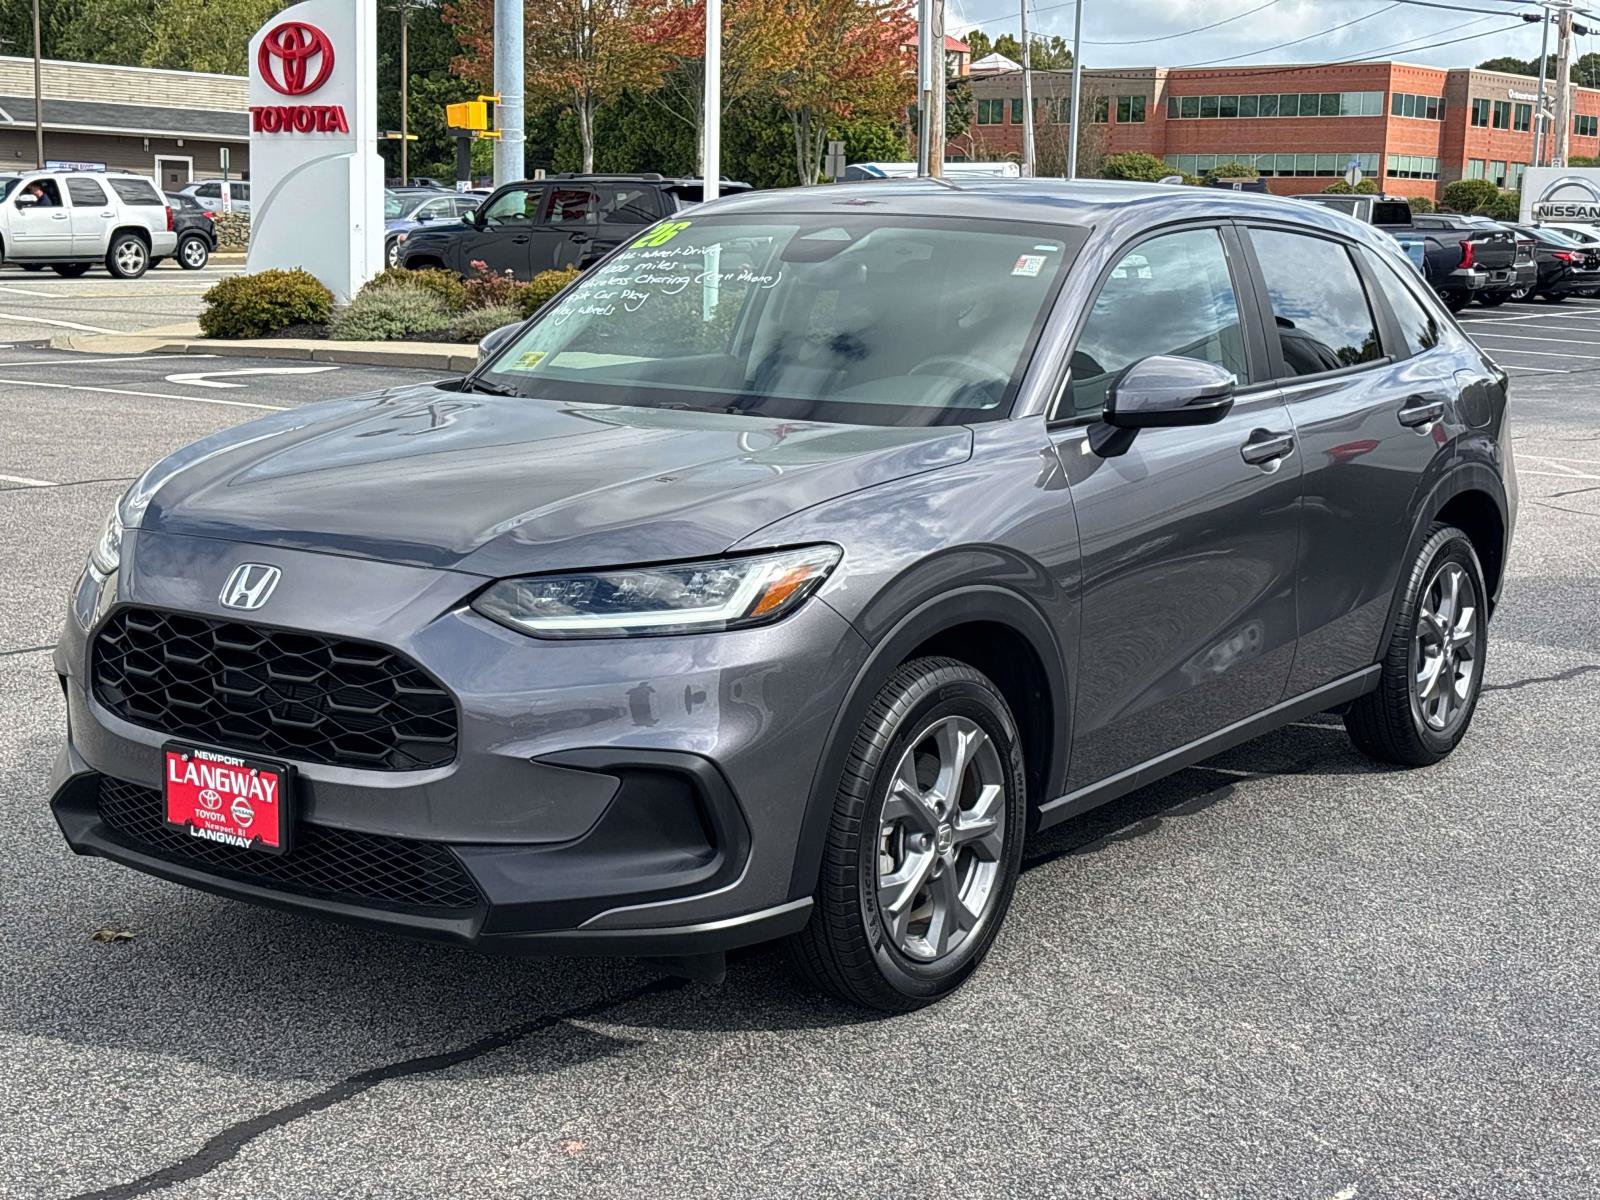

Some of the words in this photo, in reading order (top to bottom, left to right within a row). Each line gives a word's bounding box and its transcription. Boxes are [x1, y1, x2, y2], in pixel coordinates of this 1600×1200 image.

[249, 105, 349, 133] TOYOTA
[1538, 205, 1600, 218] NISSAN
[628, 221, 692, 249] 26
[634, 259, 678, 271] miles
[620, 289, 651, 312] Play
[194, 750, 245, 768] NEWPORT
[169, 759, 277, 803] LANGWAY
[194, 808, 227, 823] TOYOTA
[190, 825, 252, 849] LANGWAY
